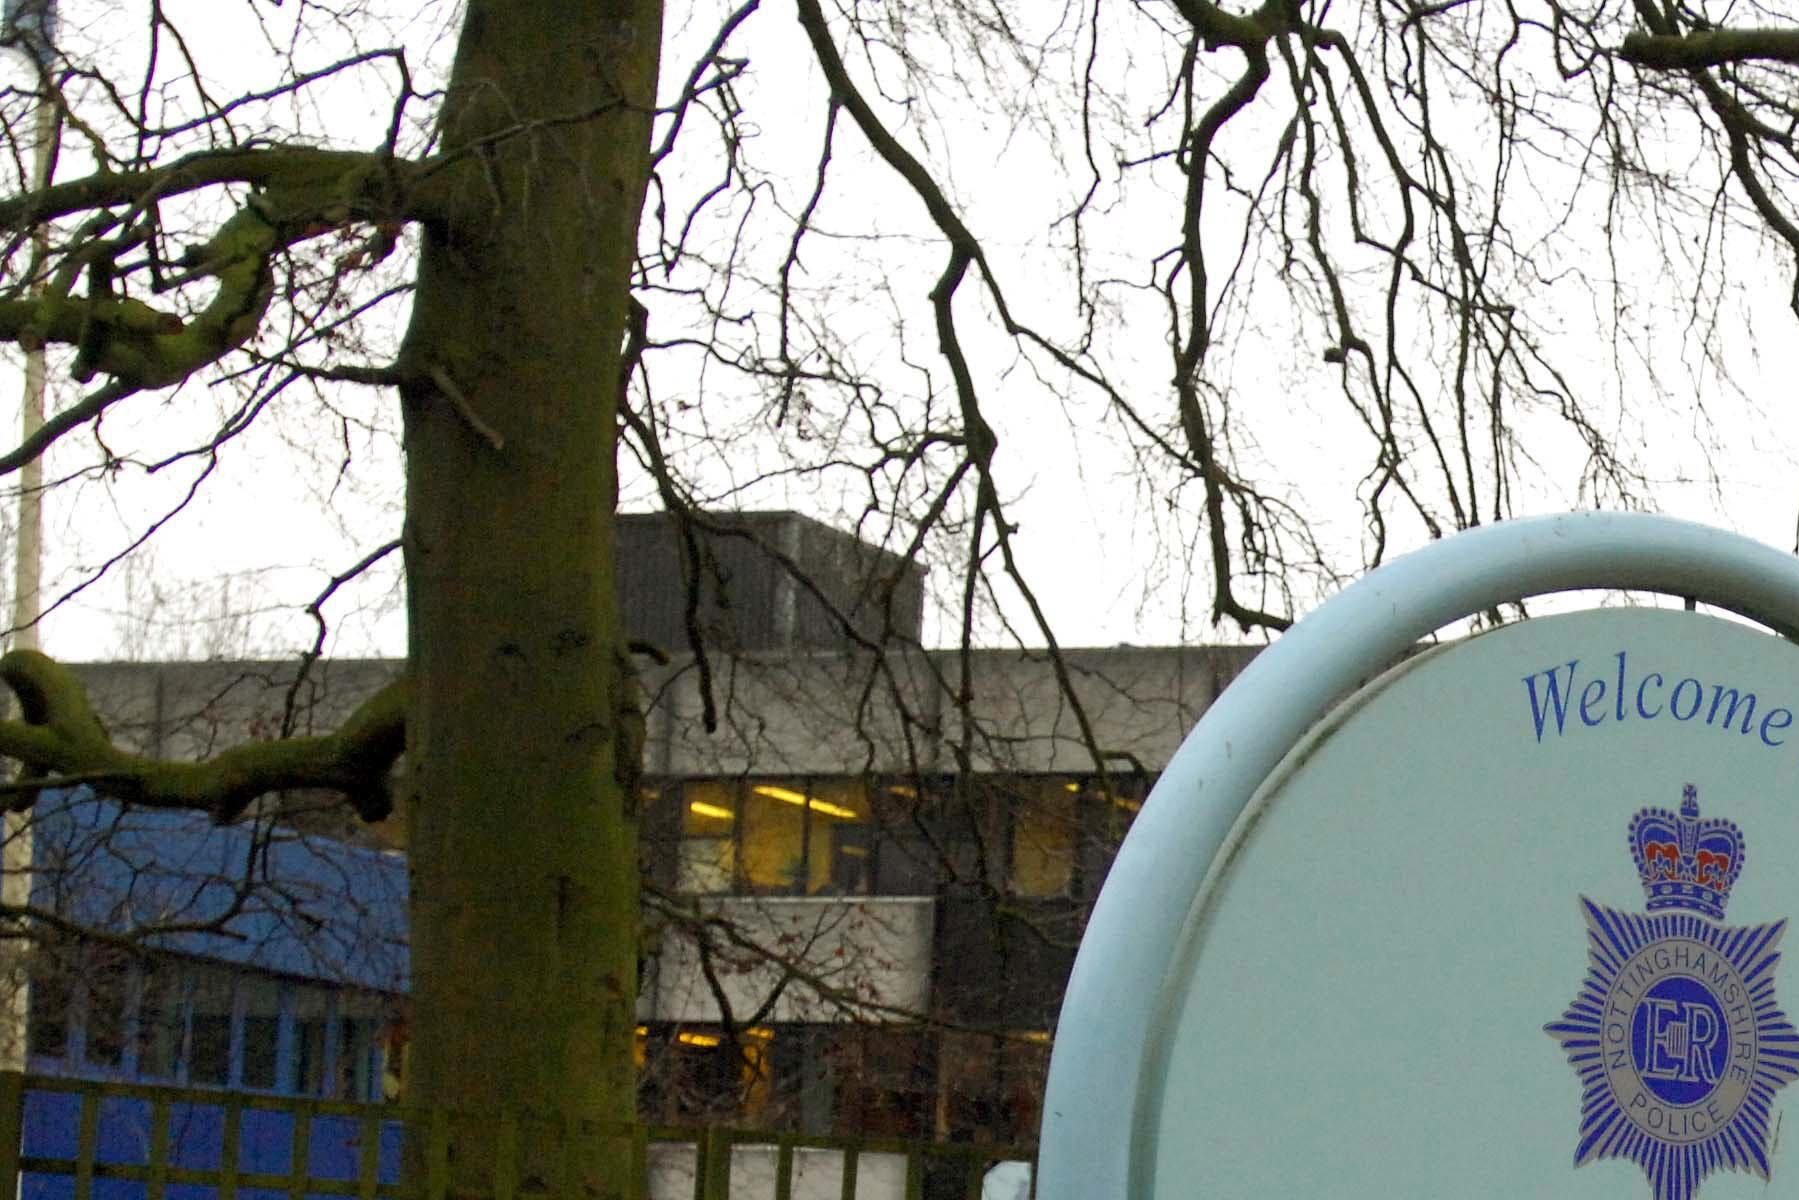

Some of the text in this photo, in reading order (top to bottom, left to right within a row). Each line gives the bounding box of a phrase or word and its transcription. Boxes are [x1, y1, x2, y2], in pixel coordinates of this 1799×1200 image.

[1522, 651, 1793, 744] Welcome
[1607, 946, 1752, 1086] NOTTINGHAMSHIRE
[1630, 1092, 1724, 1137] POLICE
